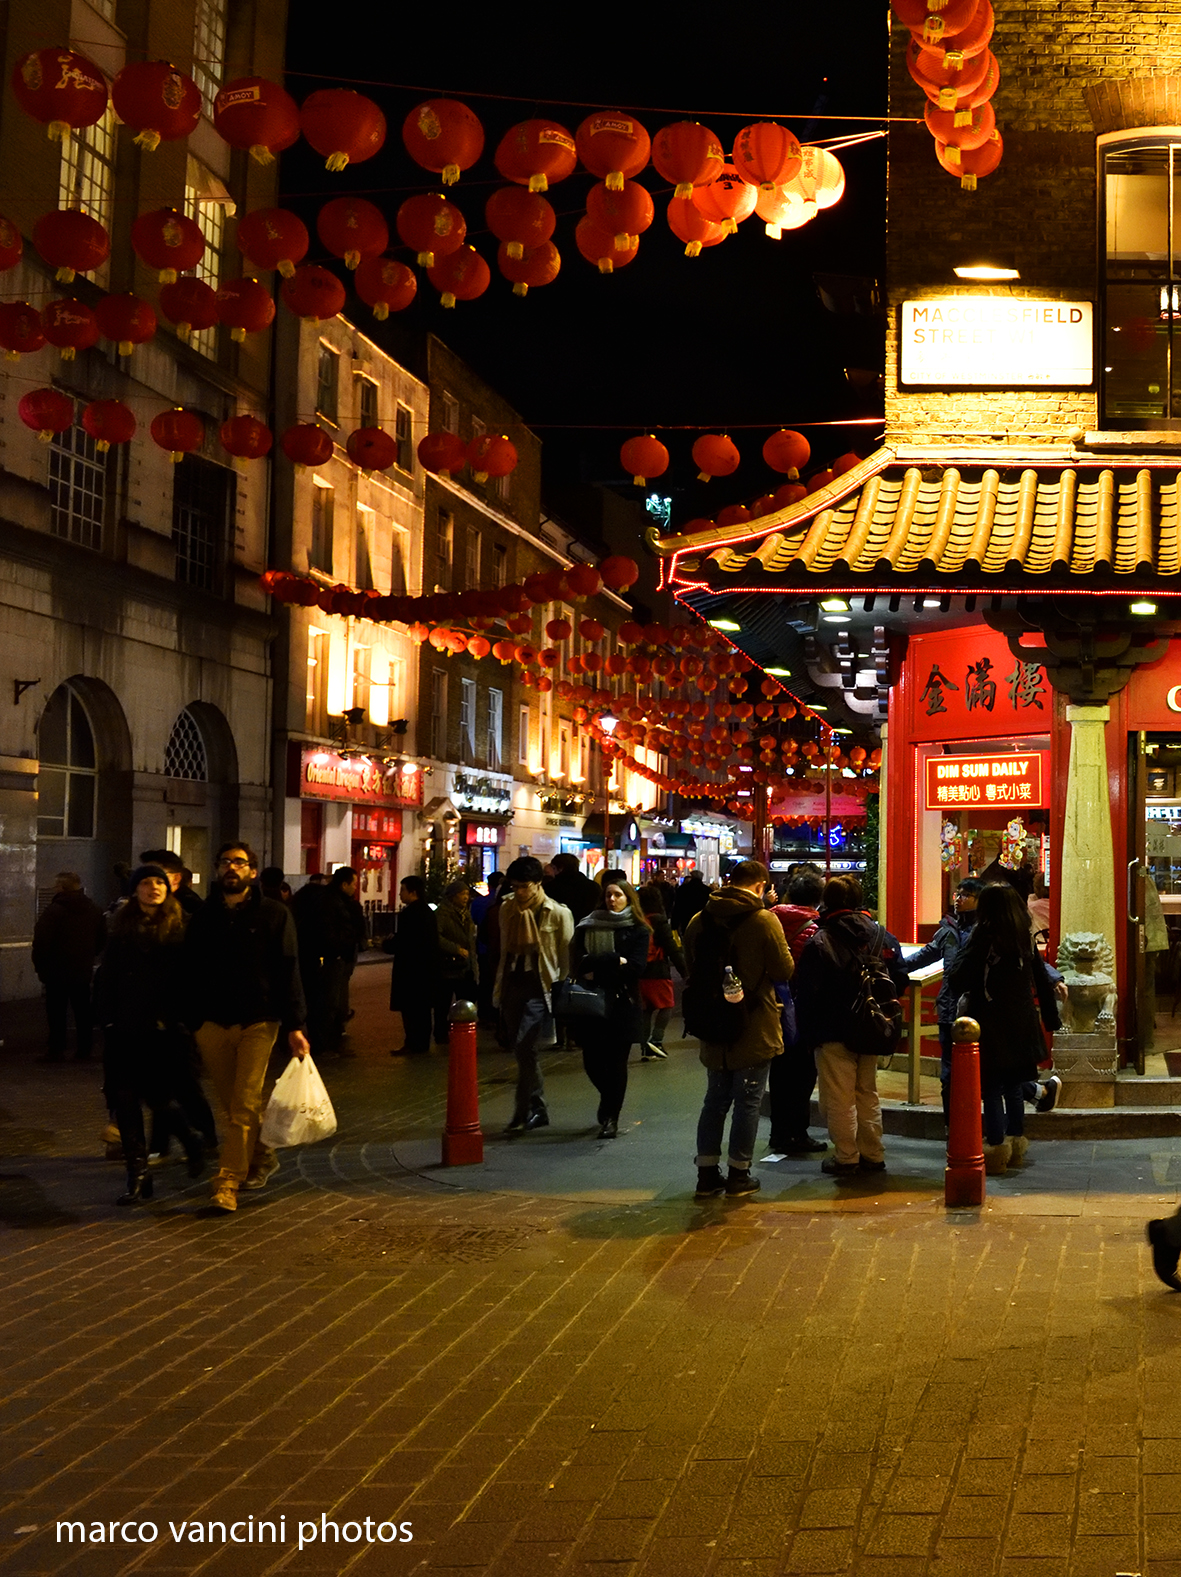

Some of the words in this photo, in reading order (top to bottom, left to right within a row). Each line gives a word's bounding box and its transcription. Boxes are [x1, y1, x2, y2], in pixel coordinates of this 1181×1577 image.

[229, 91, 252, 101] AMOY
[605, 121, 629, 130] AMOY
[912, 307, 1084, 323] MACCLESFIELD
[913, 328, 996, 344] STREET
[1008, 329, 1034, 344] W1
[919, 657, 1047, 717] 金滿樓
[937, 764, 959, 779] DIM
[962, 763, 989, 778] SUM
[992, 760, 1029, 777] DAILY
